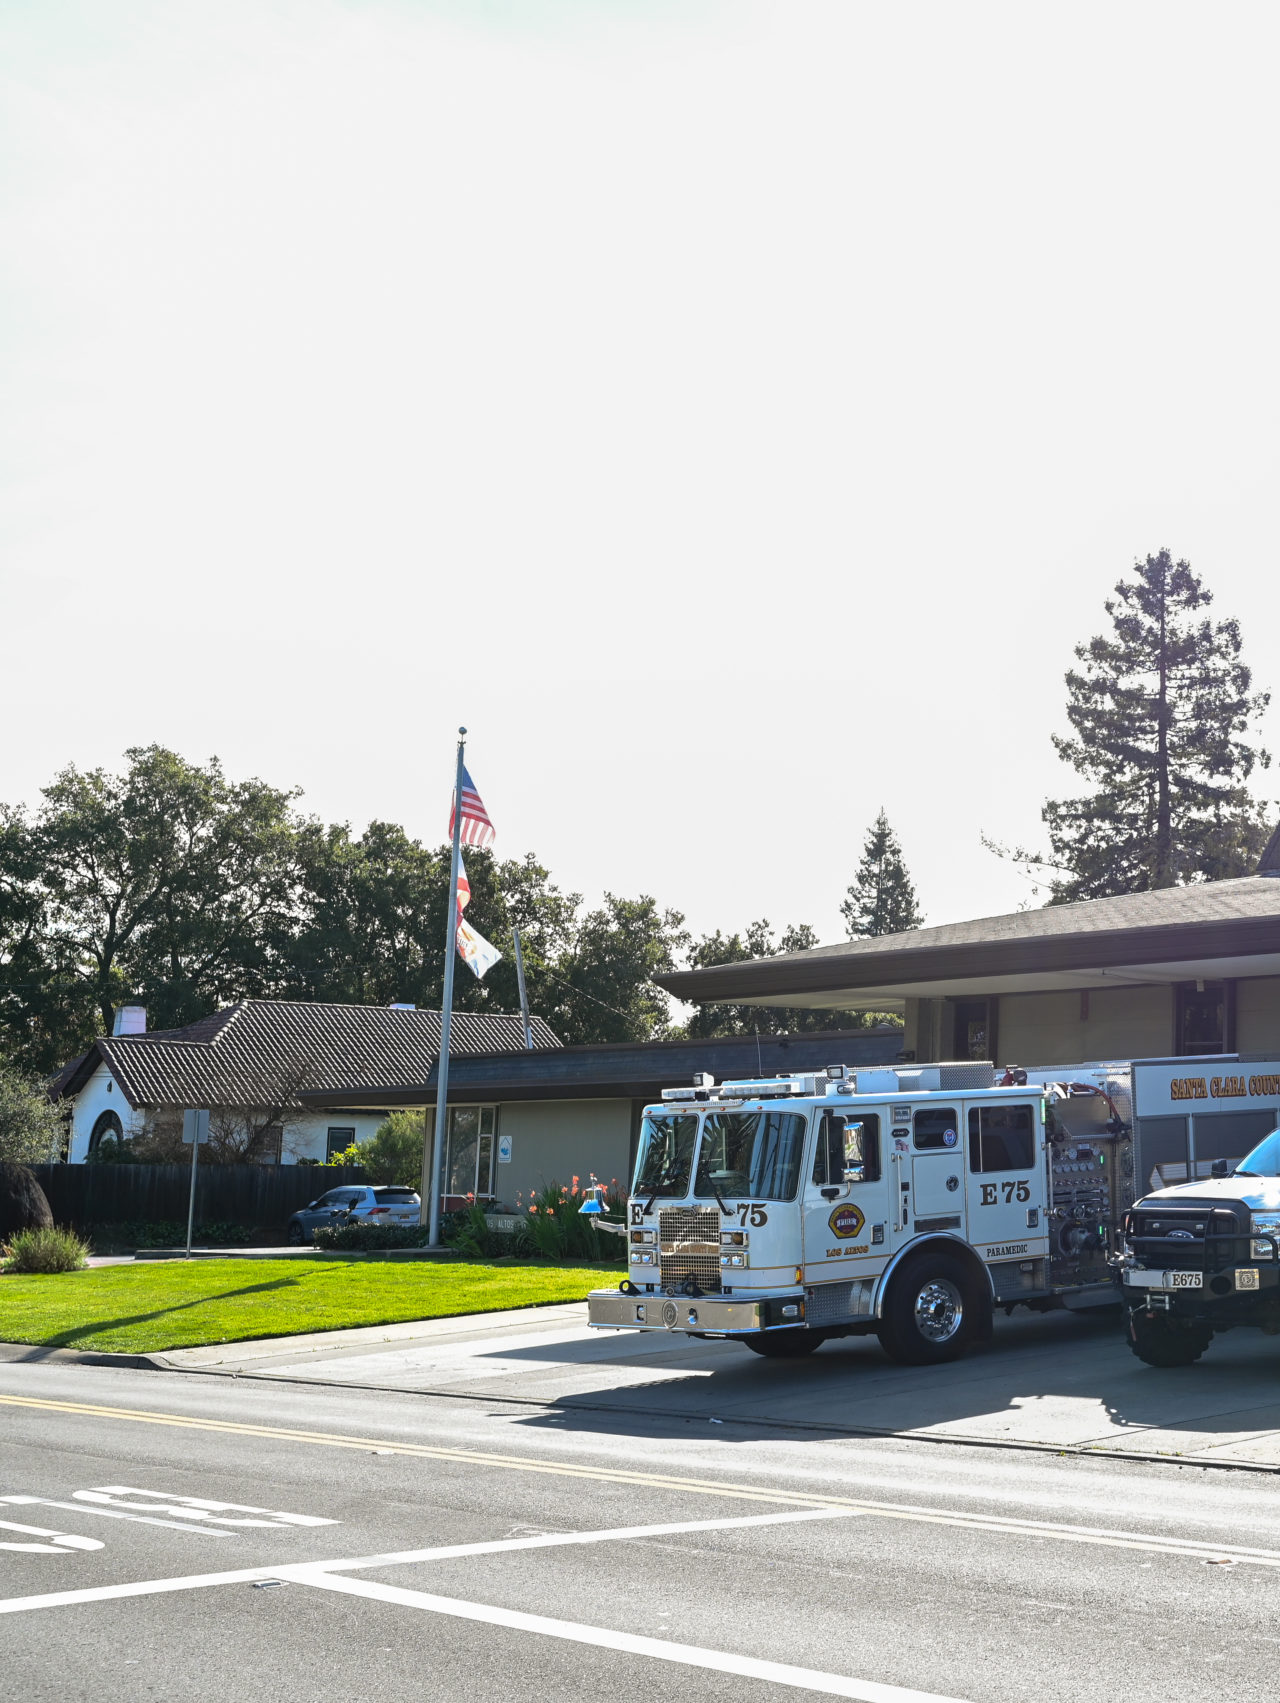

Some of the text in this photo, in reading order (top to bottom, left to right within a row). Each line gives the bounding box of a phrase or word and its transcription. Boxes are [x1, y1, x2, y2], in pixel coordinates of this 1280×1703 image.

[1171, 1078, 1208, 1100] SANTA
[1210, 1076, 1247, 1098] CLARA
[737, 1203, 768, 1227] 75
[987, 1244, 1028, 1257] PARAMEDIC
[1172, 1273, 1201, 1287] E675
